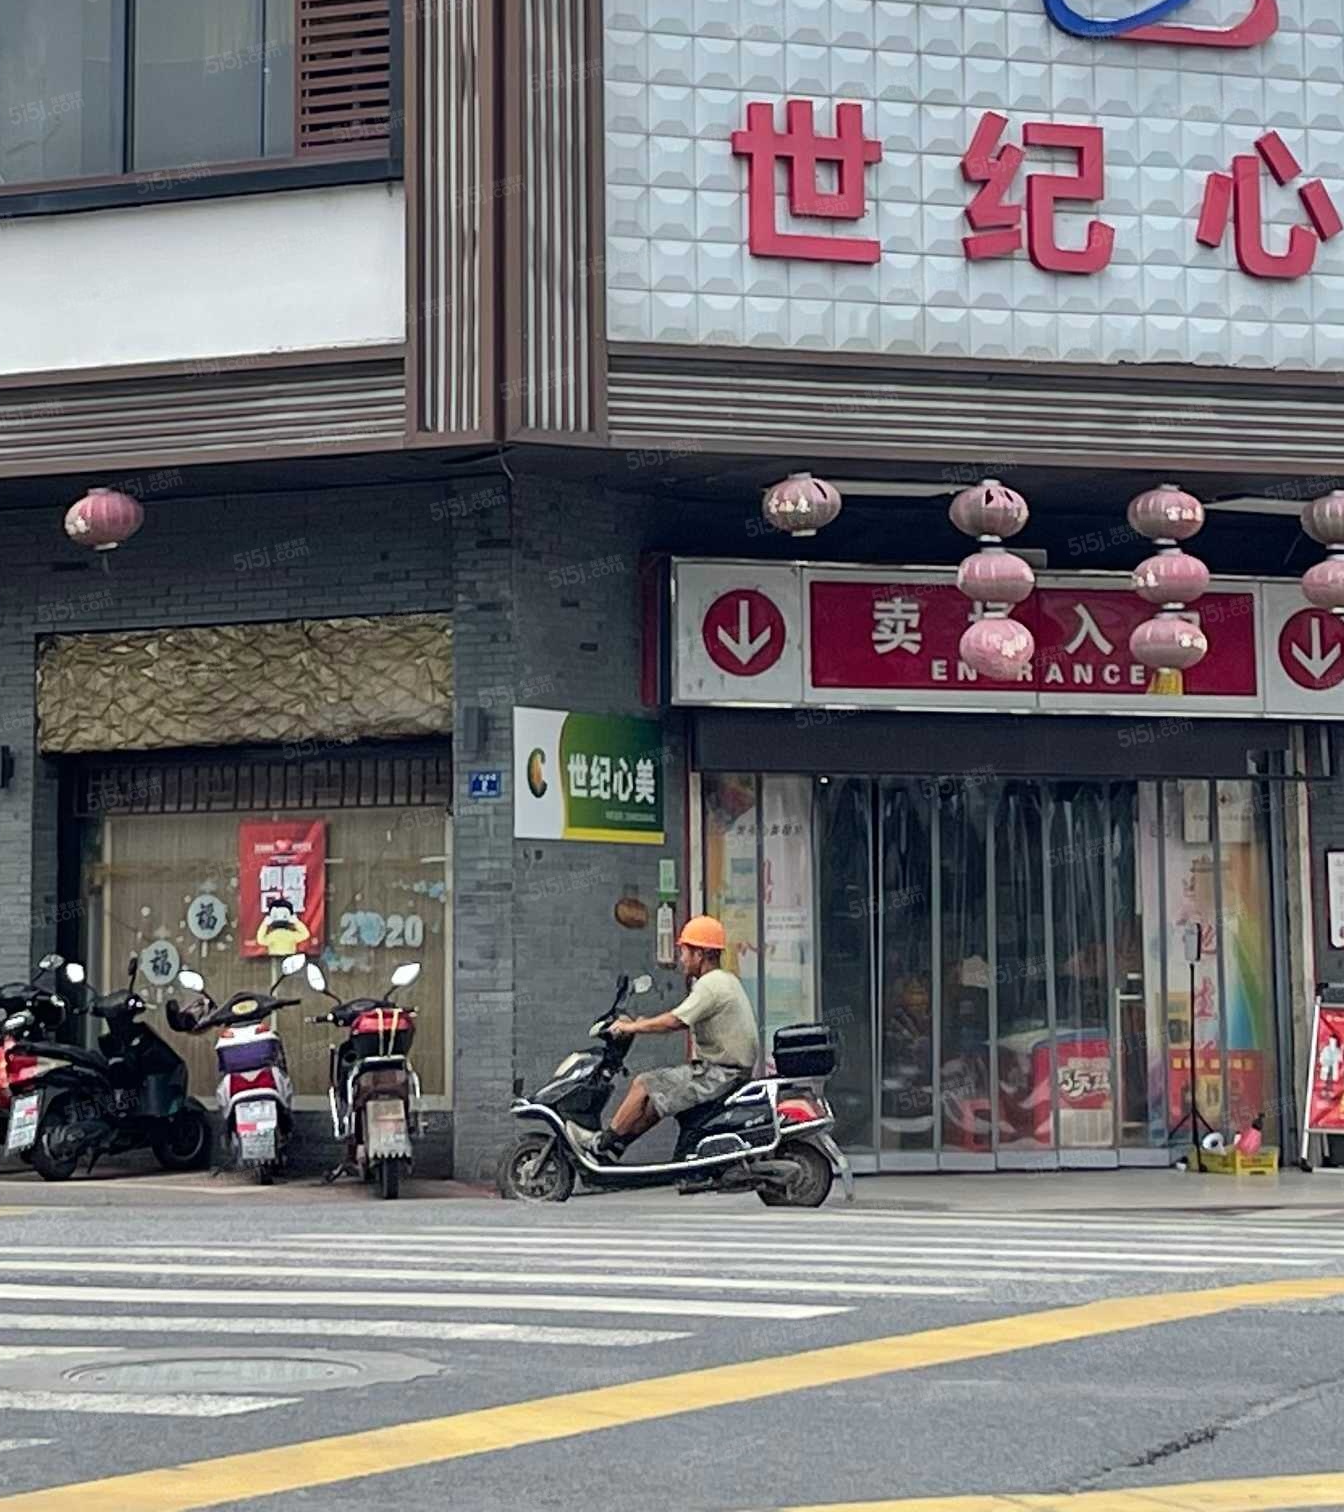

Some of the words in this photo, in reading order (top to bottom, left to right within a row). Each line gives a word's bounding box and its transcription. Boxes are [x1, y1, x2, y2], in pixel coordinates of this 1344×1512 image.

[931, 658, 1147, 687] ENRANCE
[567, 752, 656, 804] 世纪心美
[195, 902, 218, 930] 福
[149, 956, 173, 979] 福
